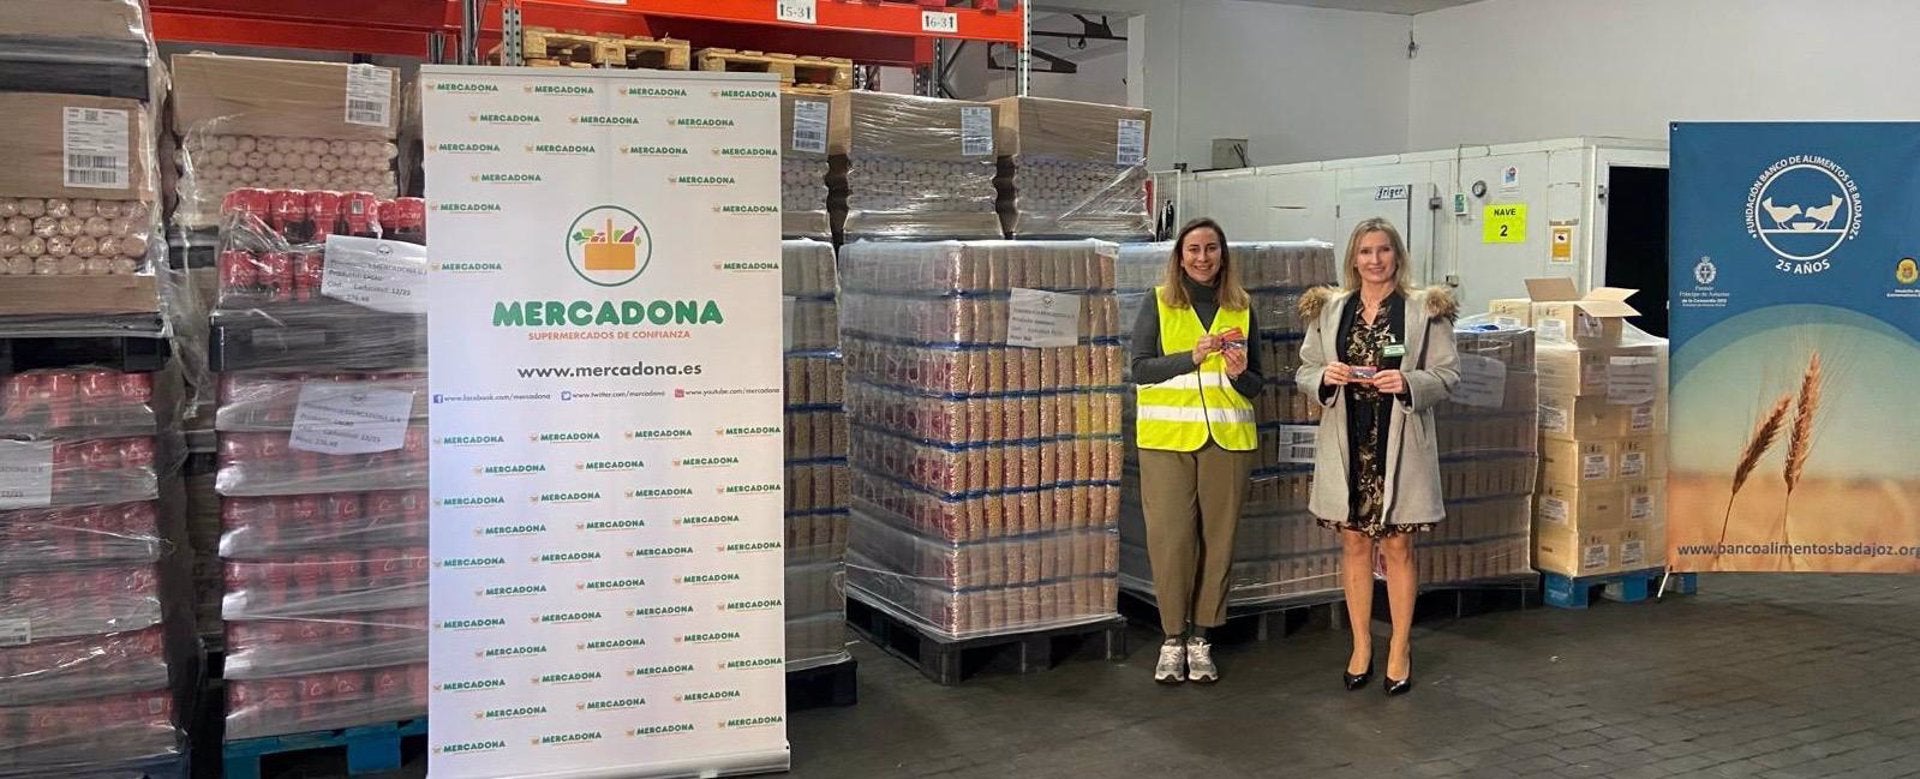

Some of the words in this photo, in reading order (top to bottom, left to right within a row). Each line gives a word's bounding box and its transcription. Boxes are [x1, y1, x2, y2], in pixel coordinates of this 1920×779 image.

[437, 83, 498, 93] MERCADONA
[534, 85, 594, 95] MERCADONA
[629, 87, 687, 97] MERCADONA
[720, 89, 777, 99] MERCADONA
[480, 114, 540, 123] MERCADONA
[580, 116, 639, 125] MERCADONA
[677, 118, 734, 127] MERCADONA
[439, 143, 500, 152] MERCADONA
[536, 144, 595, 154] MERCADONA
[630, 146, 688, 155] MERCADONA
[721, 147, 778, 157] MERCADONA
[1788, 155, 1801, 164] DE
[1759, 159, 1788, 182] BANCO
[1802, 155, 1850, 182] ALIMENTOS
[481, 173, 541, 182] MERCADONA
[678, 176, 735, 185] MERCADONA
[1846, 181, 1858, 194] DE
[440, 203, 501, 212] MERCADONA
[722, 205, 778, 213] MERCADONA
[1746, 180, 1763, 234] FUNDACIÓN
[1494, 208, 1516, 217] NAVE
[1850, 192, 1863, 237] BADAJOZ
[1500, 225, 1508, 237] 2
[441, 263, 502, 271] MERCADONA
[723, 262, 779, 271] MERCADONA
[1775, 259, 1792, 272] 25
[1793, 258, 1831, 275] AÑOS
[493, 300, 724, 327] MERCADONA
[528, 332, 614, 341] SUPERMERCADOS
[632, 331, 690, 339] CONFIANZA
[517, 361, 702, 378] www.mercadona.es
[634, 430, 692, 439] MERCADONA
[726, 426, 781, 436] MERCADONA
[444, 435, 504, 445] MERCADONA
[540, 432, 600, 442] MERCADONA
[586, 460, 644, 470] MERCADONA
[682, 456, 739, 466] MERCADONA
[485, 464, 546, 474] MERCADONA
[635, 488, 693, 498] MERCADONA
[726, 484, 781, 493] MERCADONA
[444, 497, 505, 506] MERCADONA
[541, 492, 600, 502] MERCADONA
[586, 519, 645, 529] MERCADONA
[683, 515, 739, 525] MERCADONA
[485, 524, 546, 534] MERCADONA
[727, 542, 781, 551] MERCADONA
[541, 552, 601, 562] MERCADONA
[635, 547, 693, 557] MERCADONA
[444, 557, 505, 568] MERCADONA
[587, 579, 646, 589] MERCADONA
[684, 574, 740, 584] MERCADONA
[486, 585, 547, 595] MERCADONA
[727, 600, 782, 610] MERCADONA
[636, 605, 694, 616] MERCADONA
[542, 611, 602, 622] MERCADONA
[444, 617, 505, 629] MERCADONA
[684, 632, 740, 642] MERCADONA
[587, 639, 646, 649] MERCADONA
[486, 645, 547, 656] MERCADONA
[727, 657, 782, 668] MERCADONA
[636, 664, 694, 675] MERCADONA
[542, 671, 602, 682] MERCADONA
[444, 678, 505, 690] MERCADONA
[684, 690, 740, 701] MERCADONA
[587, 698, 646, 709] MERCADONA
[486, 706, 547, 717] MERCADONA
[727, 715, 783, 726] MERCADONA
[637, 723, 694, 734] MERCADONA
[542, 731, 602, 743] MERCADONA
[444, 740, 506, 752] MERCADONA
